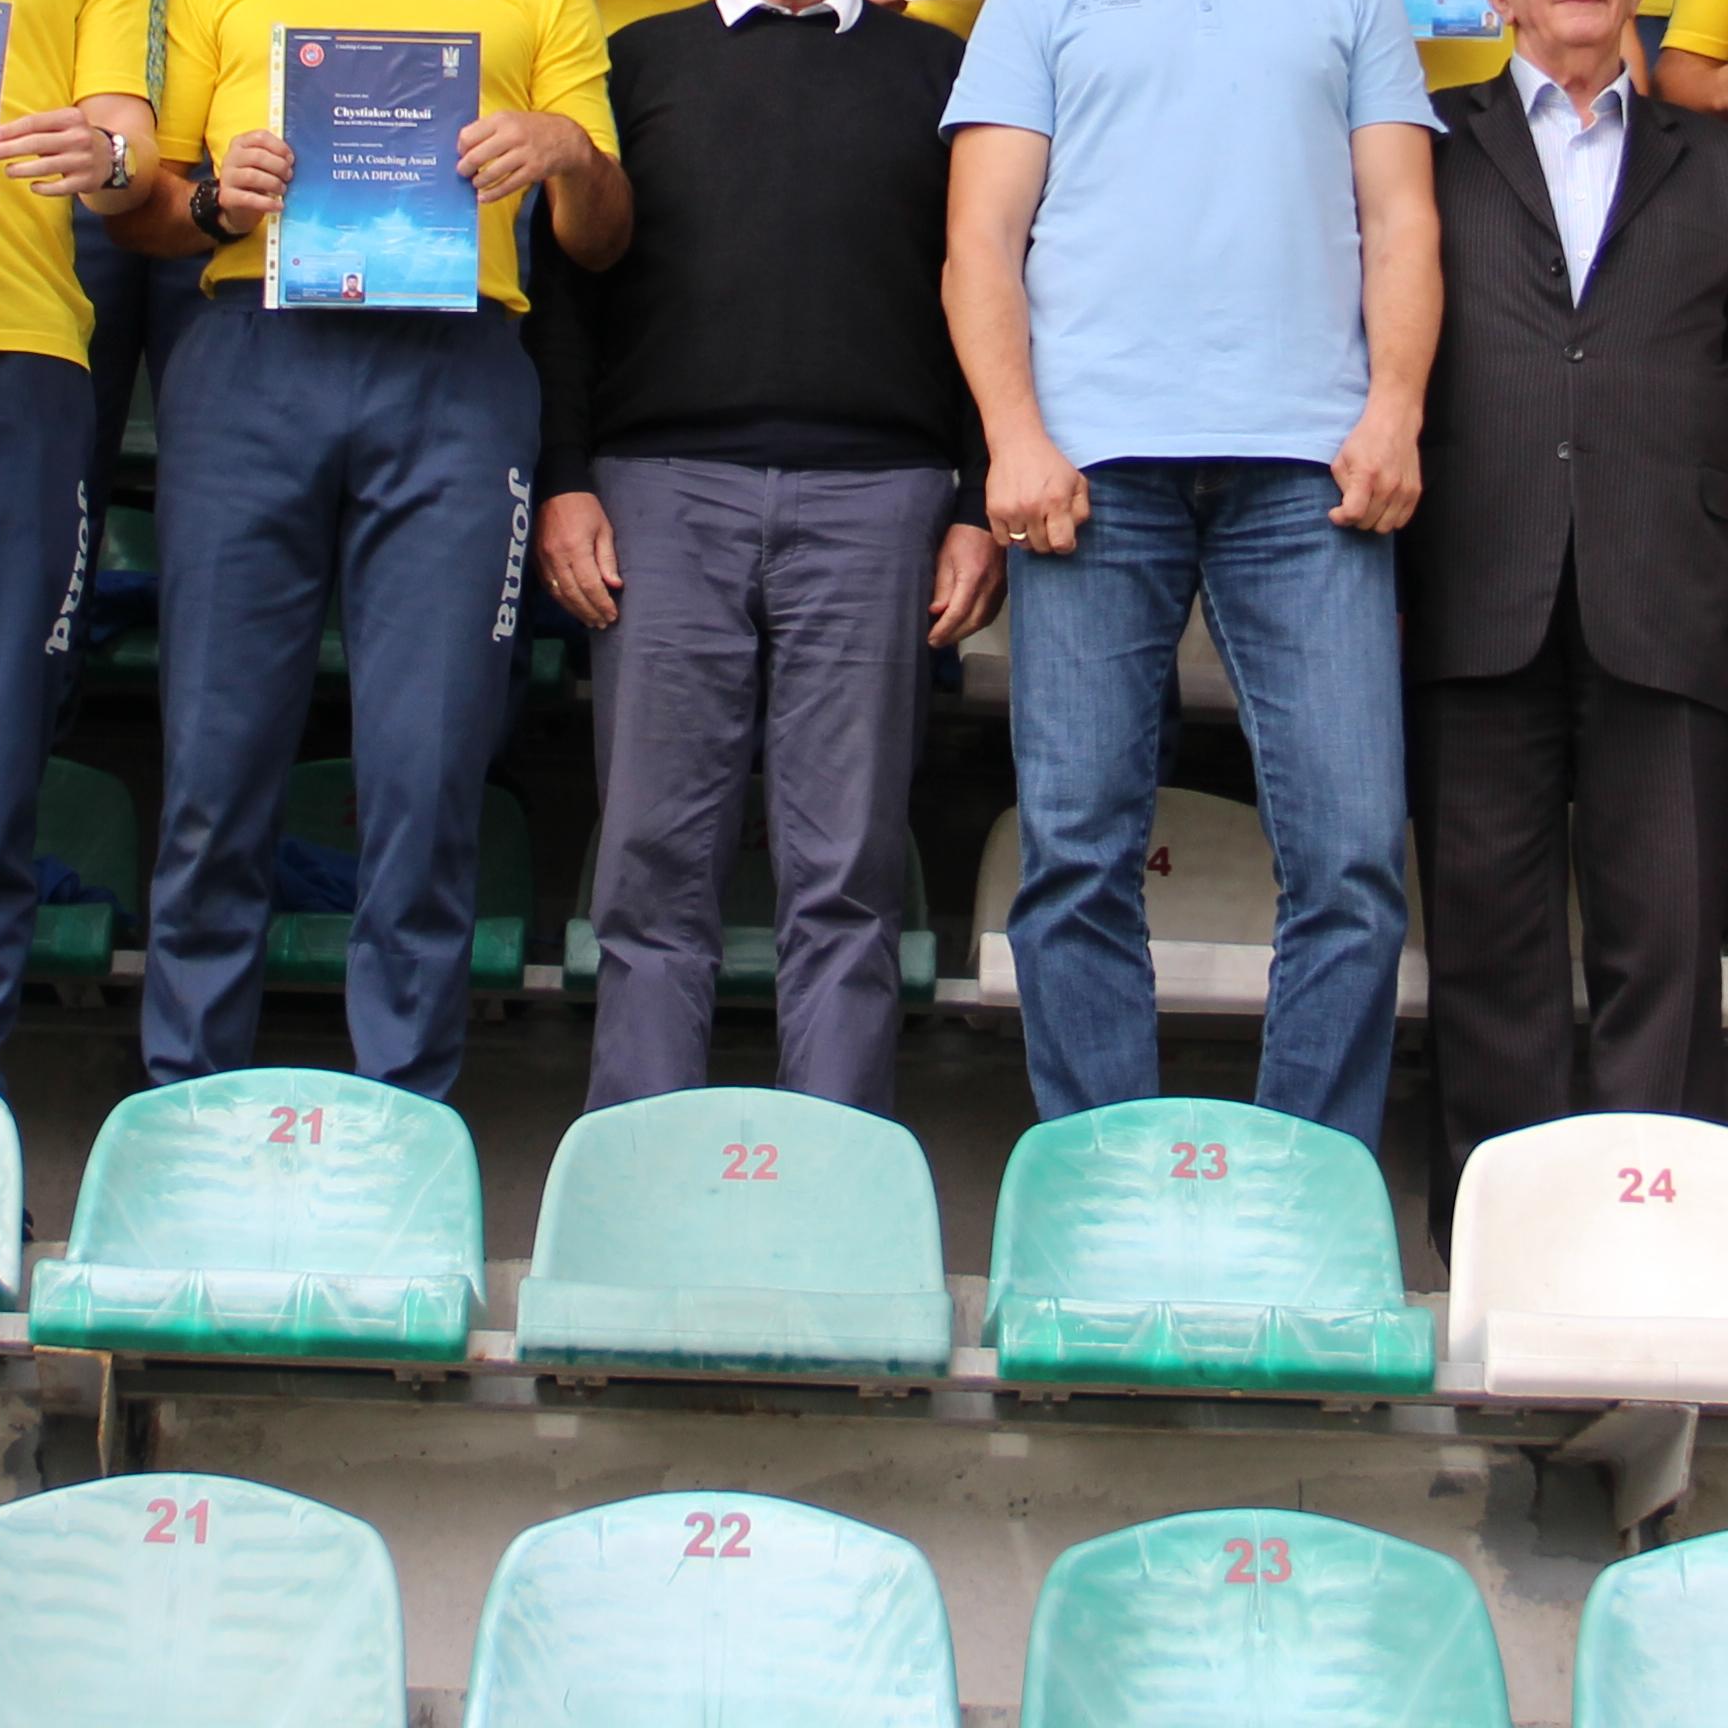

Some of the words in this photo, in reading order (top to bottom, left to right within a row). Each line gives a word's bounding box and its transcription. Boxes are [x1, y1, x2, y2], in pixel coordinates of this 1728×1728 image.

[333, 106, 392, 120] Chystiakov
[394, 107, 432, 119] Oleksii
[333, 154, 354, 164] UAF
[357, 155, 365, 164] A
[366, 155, 406, 167] Coaching
[408, 156, 436, 166] Award
[333, 170, 360, 180] UEFA
[361, 170, 369, 180] A
[371, 170, 420, 182] DIPLOMA
[44, 479, 88, 655] Joma
[492, 467, 532, 643] Joma
[1148, 847, 1172, 875] 4
[270, 1107, 323, 1143] 21
[723, 1144, 778, 1180] 22
[1172, 1143, 1227, 1180] 23
[1619, 1168, 1675, 1203] 24
[145, 1499, 208, 1543] 21
[685, 1513, 752, 1557] 22
[1226, 1539, 1291, 1584] 23
